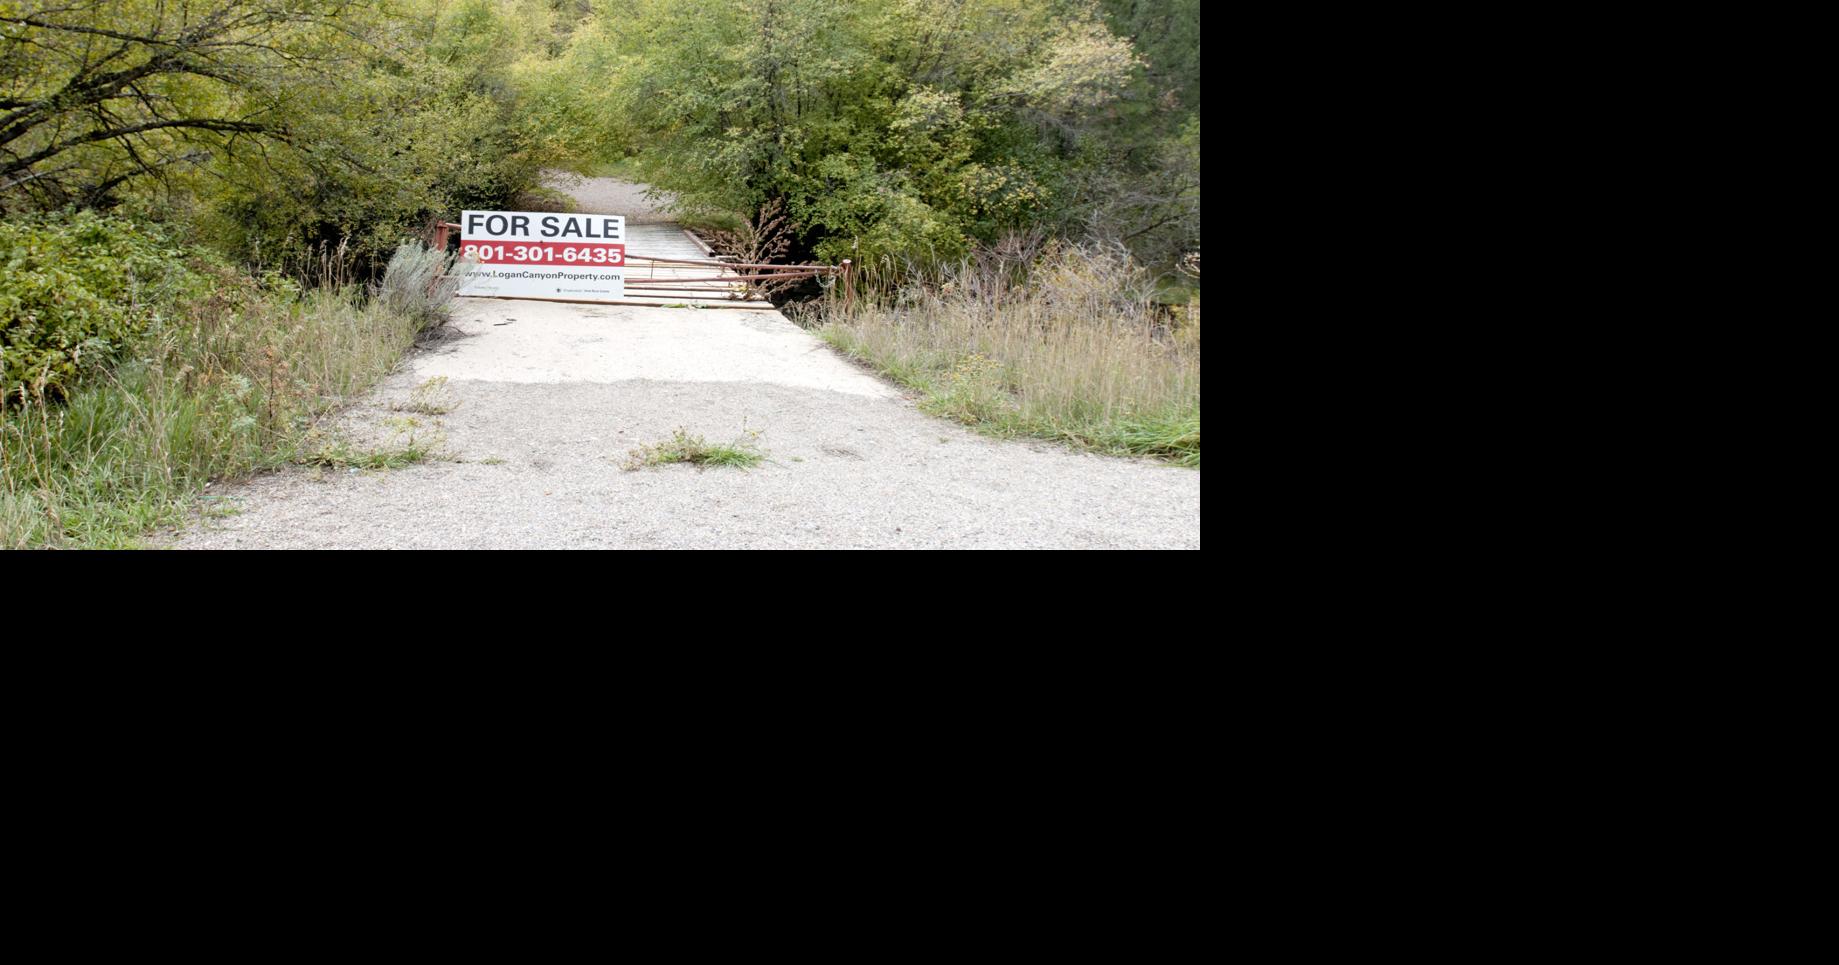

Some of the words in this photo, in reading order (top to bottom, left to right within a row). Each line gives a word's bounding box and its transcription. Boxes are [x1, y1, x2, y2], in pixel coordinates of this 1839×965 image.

[468, 214, 530, 237] FOR
[540, 216, 620, 239] SALE
[463, 244, 622, 263] 801-301-6435
[464, 270, 620, 281] www.LoganCanyonProperty.com
